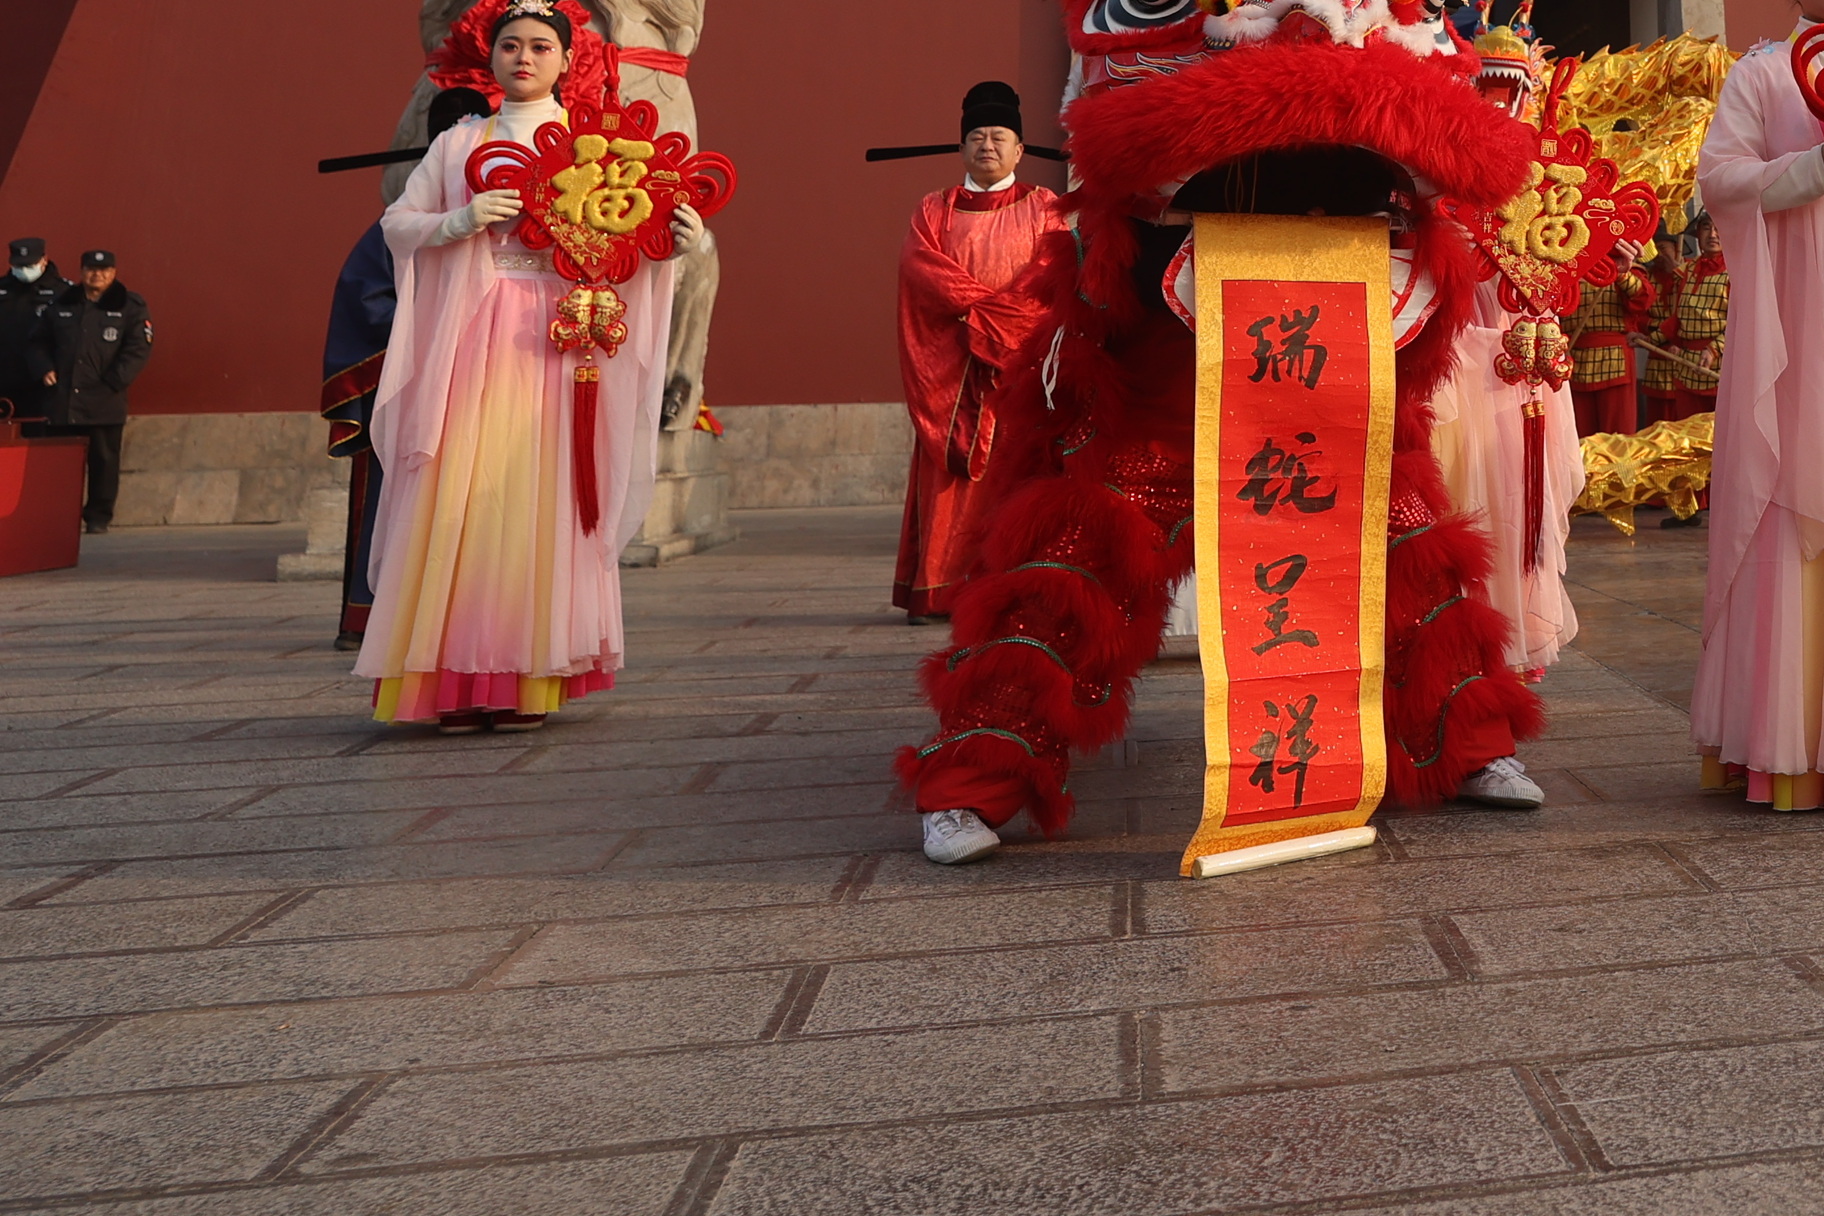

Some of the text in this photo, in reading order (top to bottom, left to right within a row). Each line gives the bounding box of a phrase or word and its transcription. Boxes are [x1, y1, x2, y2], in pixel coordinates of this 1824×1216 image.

[551, 134, 655, 234] 福
[1496, 160, 1591, 264] 福
[1235, 304, 1338, 809] 瑞蛇呈祥
